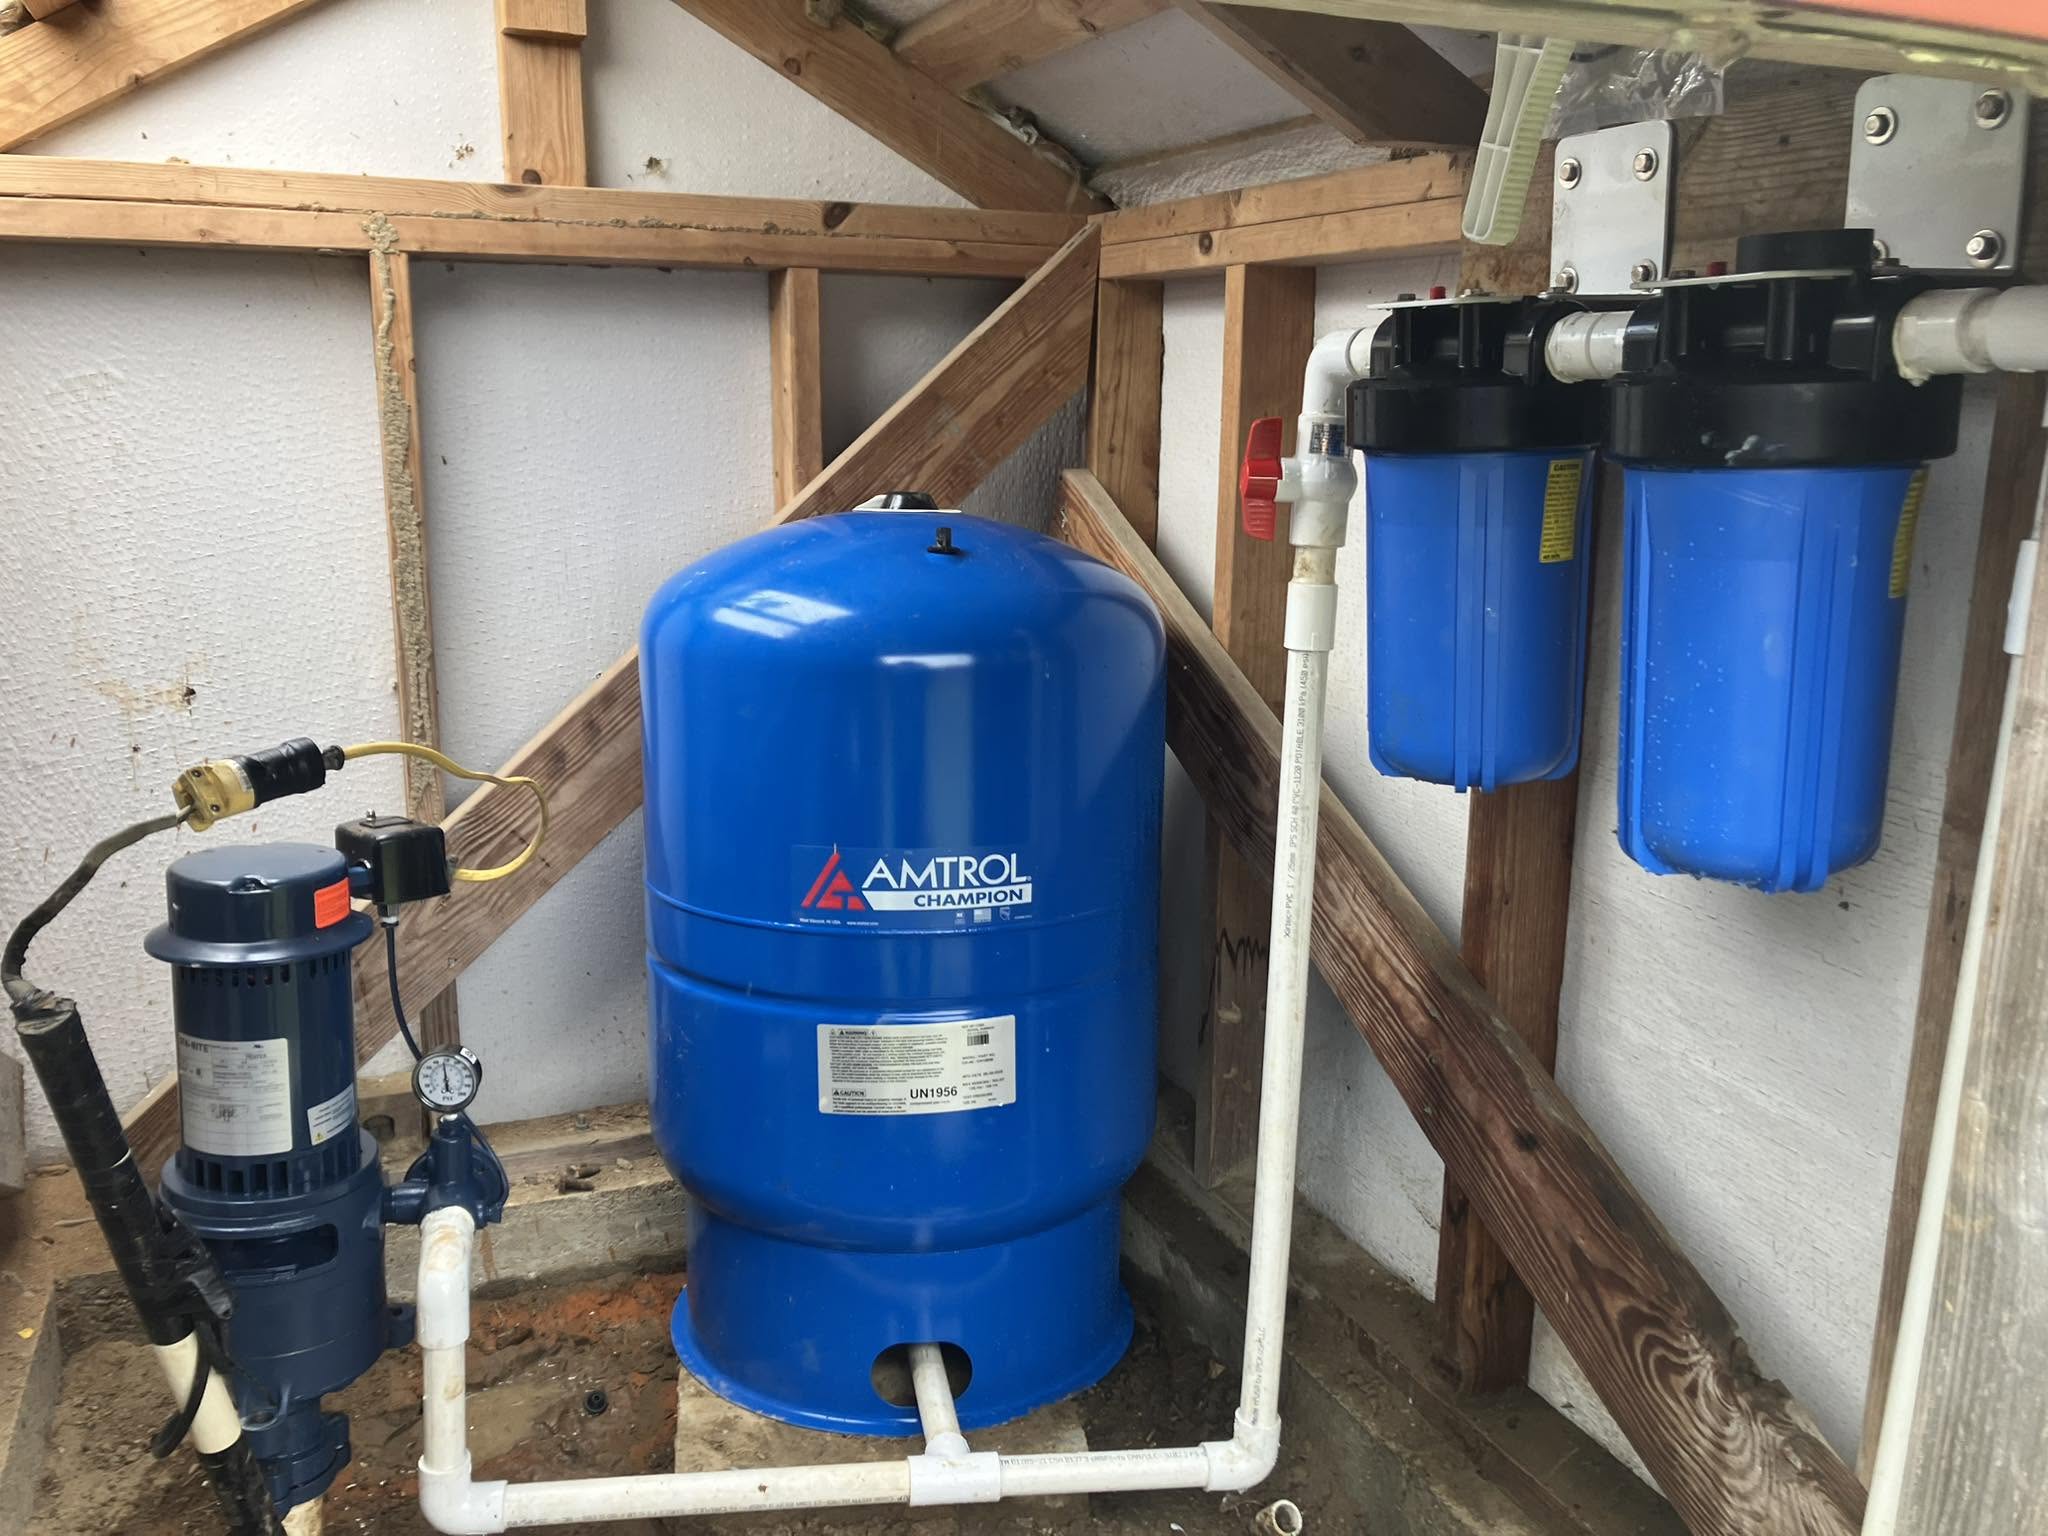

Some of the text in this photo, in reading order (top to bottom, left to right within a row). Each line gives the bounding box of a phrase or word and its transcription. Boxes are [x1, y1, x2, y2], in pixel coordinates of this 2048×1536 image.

[1285, 893, 1294, 909] PVC
[1290, 817, 1298, 832] SCH
[1295, 729, 1304, 764] POTABLE
[861, 852, 1027, 889] AMTROL
[914, 888, 1023, 907] CHAMPION
[910, 1086, 958, 1099] UN1956
